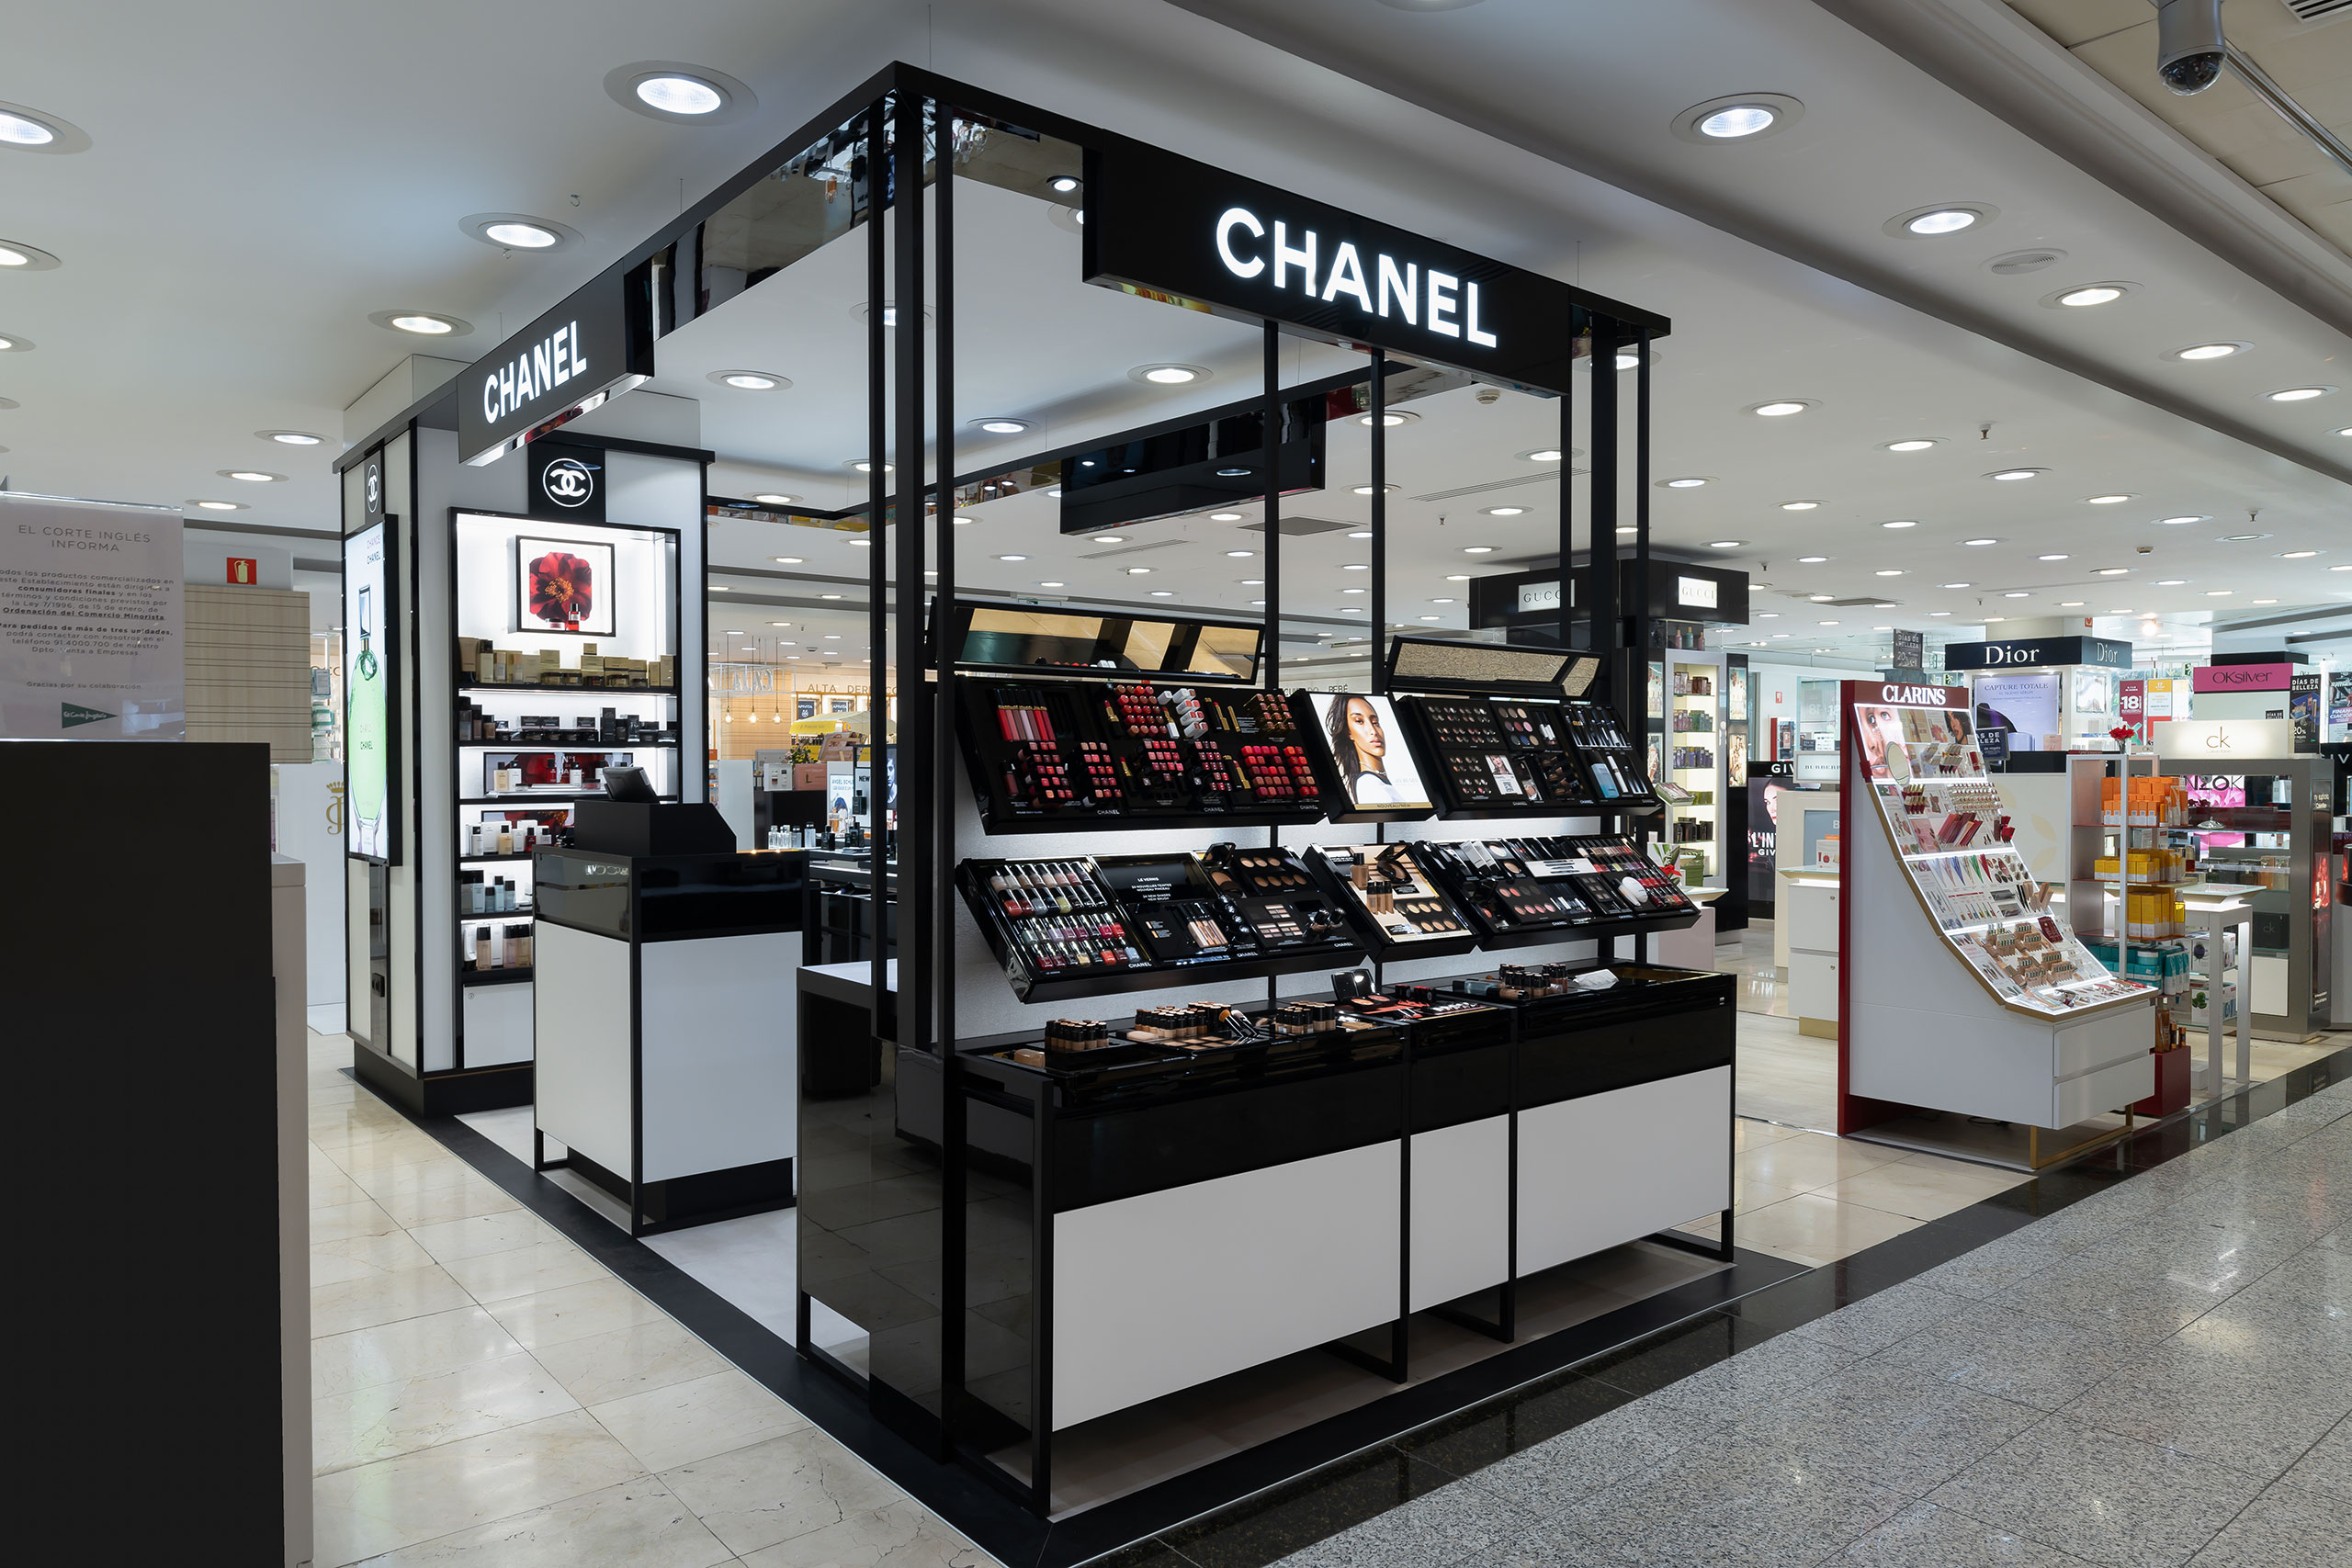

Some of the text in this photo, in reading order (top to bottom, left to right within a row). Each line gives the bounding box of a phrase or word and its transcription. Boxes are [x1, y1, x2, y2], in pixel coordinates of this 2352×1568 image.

[1216, 208, 1497, 348] CHANEL
[483, 321, 587, 424] CHANEL
[18, 525, 151, 543] EL CORTE INGLÉS
[51, 539, 119, 552] INFORMA
[21, 578, 94, 587] Establecimiento
[91, 575, 161, 584] comercializados
[54, 595, 107, 604] condiciones
[1523, 589, 1560, 603] GUCC
[1681, 586, 1714, 600] GUCCI
[3, 607, 57, 615] Ordenación
[78, 611, 120, 619] Comercio
[1984, 645, 2040, 664] Dior
[2097, 643, 2119, 663] Dior
[808, 683, 837, 693] ALTA
[1883, 684, 1946, 705] CLARINS
[2206, 727, 2231, 748] ck
